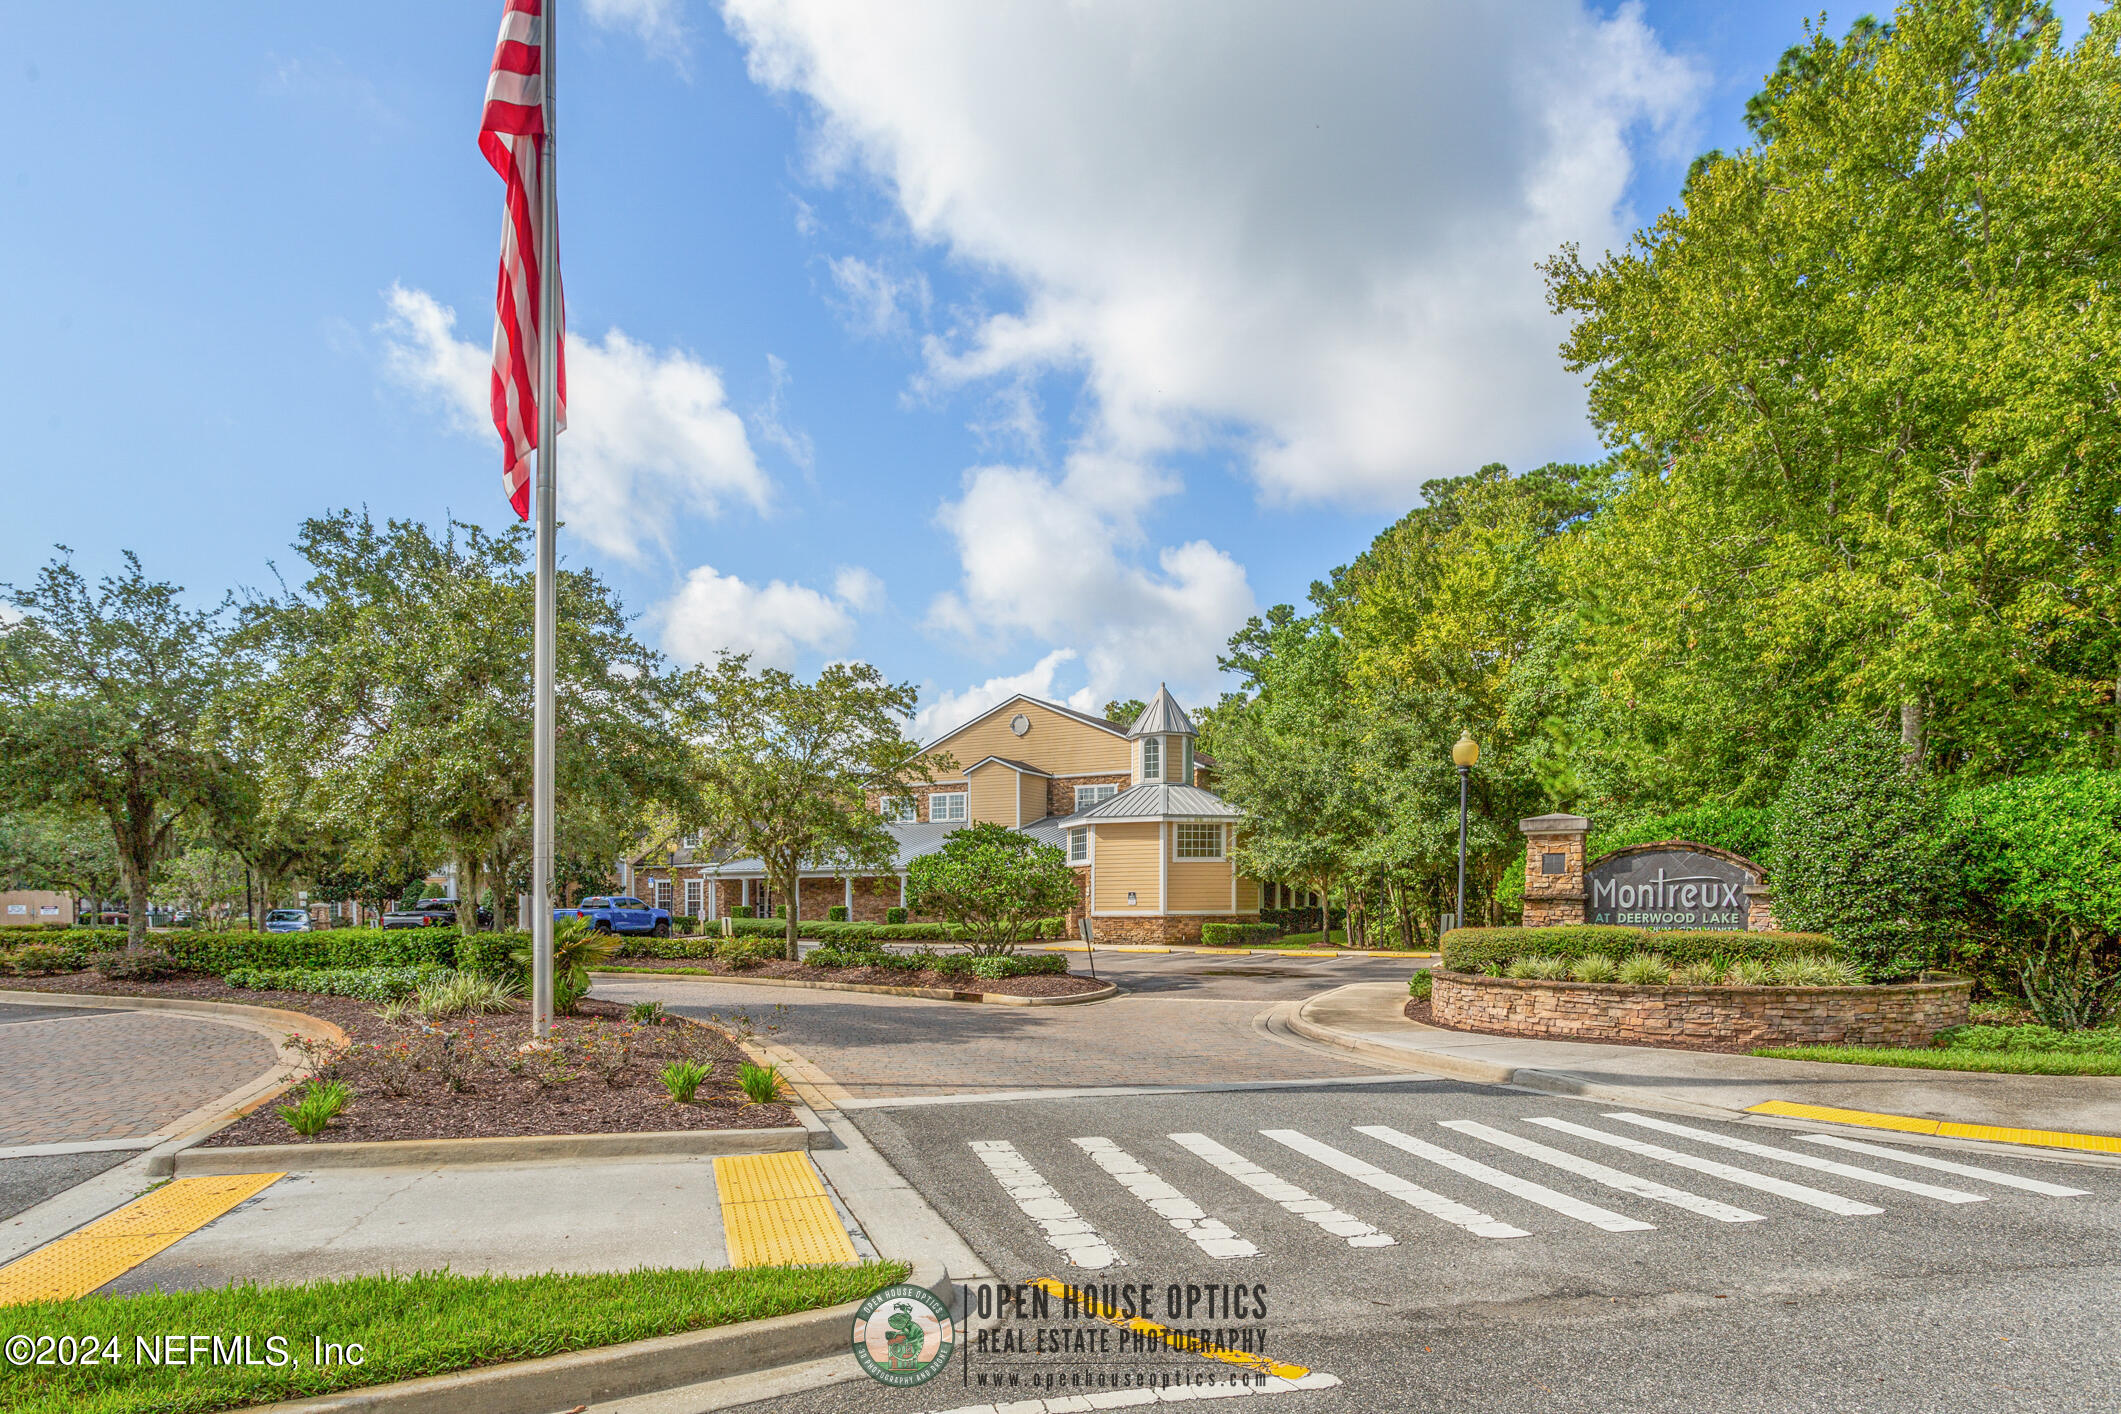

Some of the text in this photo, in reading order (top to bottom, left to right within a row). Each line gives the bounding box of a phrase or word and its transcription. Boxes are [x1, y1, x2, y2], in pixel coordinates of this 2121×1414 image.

[1593, 867, 1739, 909] Montreux
[1595, 912, 1739, 924] AT DEERWOOD LAKE
